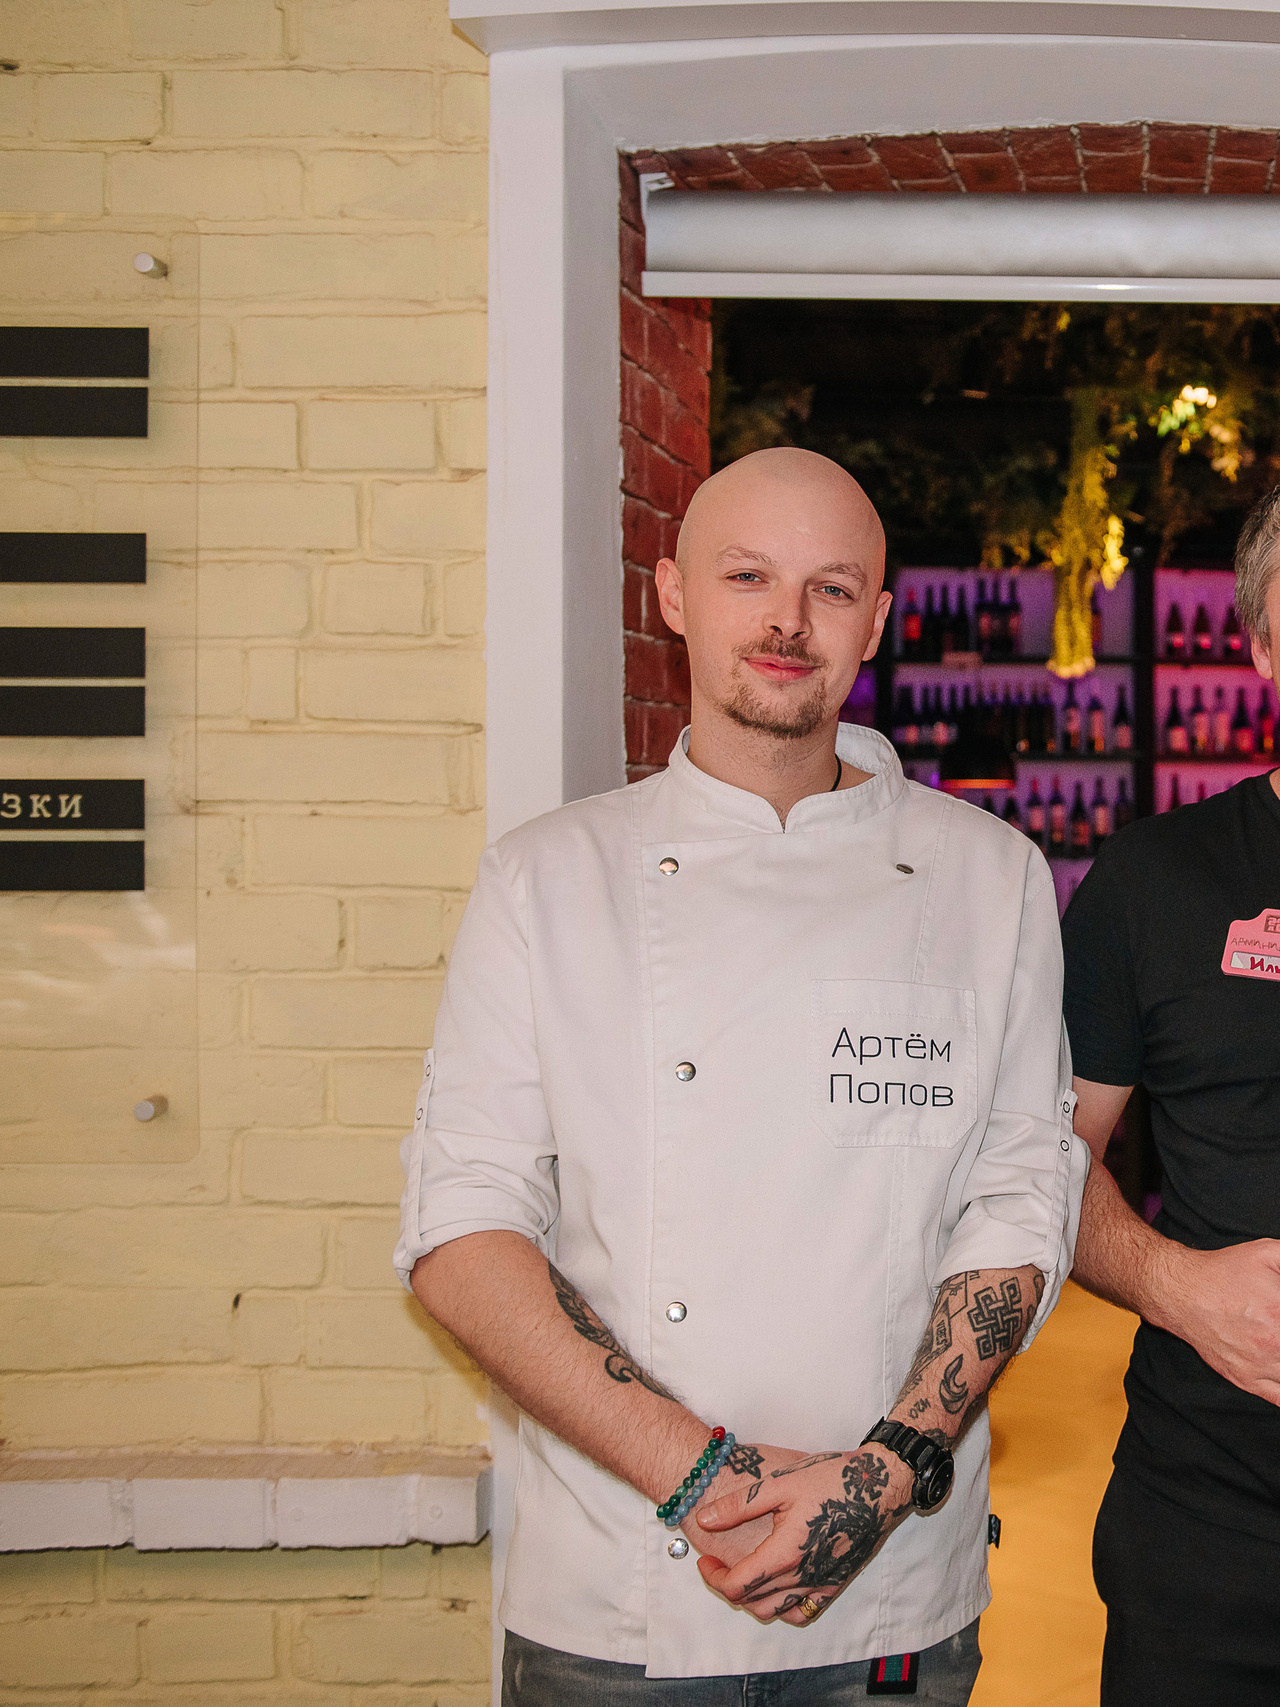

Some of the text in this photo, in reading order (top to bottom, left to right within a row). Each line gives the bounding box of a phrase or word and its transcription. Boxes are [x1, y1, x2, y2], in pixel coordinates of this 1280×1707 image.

[0, 792, 83, 818] ЗКИ
[831, 1027, 951, 1065] Артём
[830, 1073, 954, 1107] Попов
